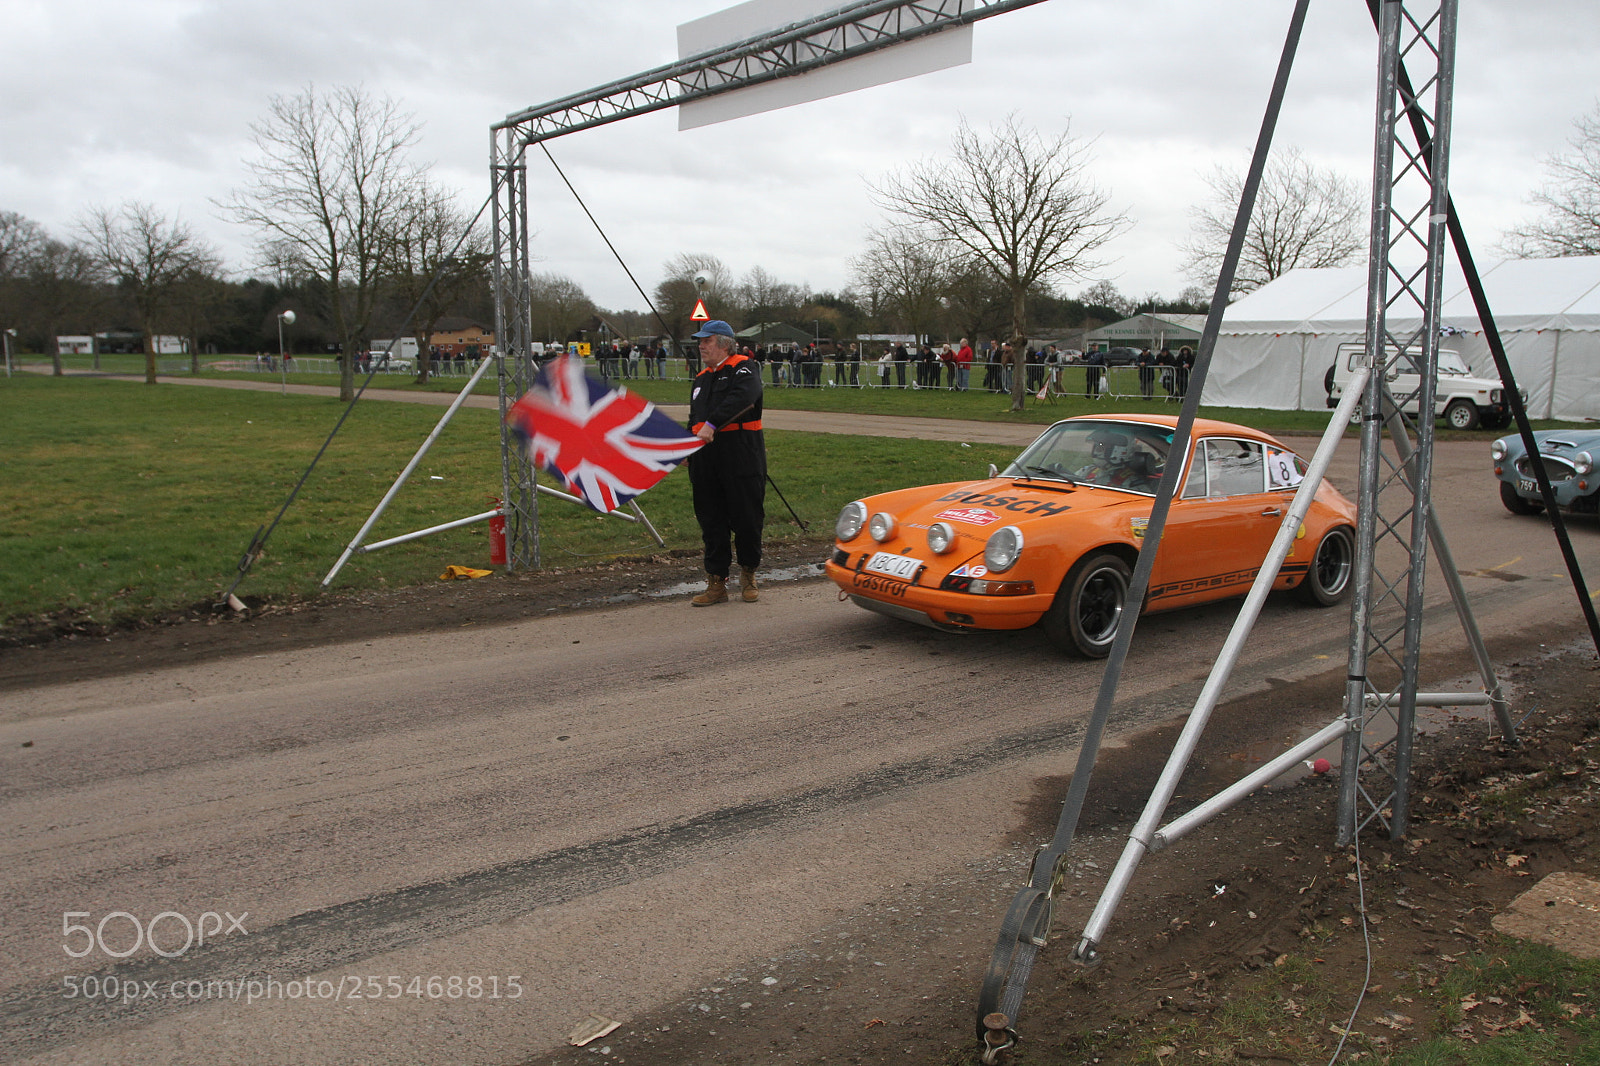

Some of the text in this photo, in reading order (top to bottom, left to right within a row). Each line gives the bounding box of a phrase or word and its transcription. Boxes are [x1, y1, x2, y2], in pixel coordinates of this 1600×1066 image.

[1279, 461, 1290, 481] 8
[1520, 480, 1534, 491] 759
[936, 491, 1072, 517] BOSCH
[1164, 570, 1261, 593] PORSCHE
